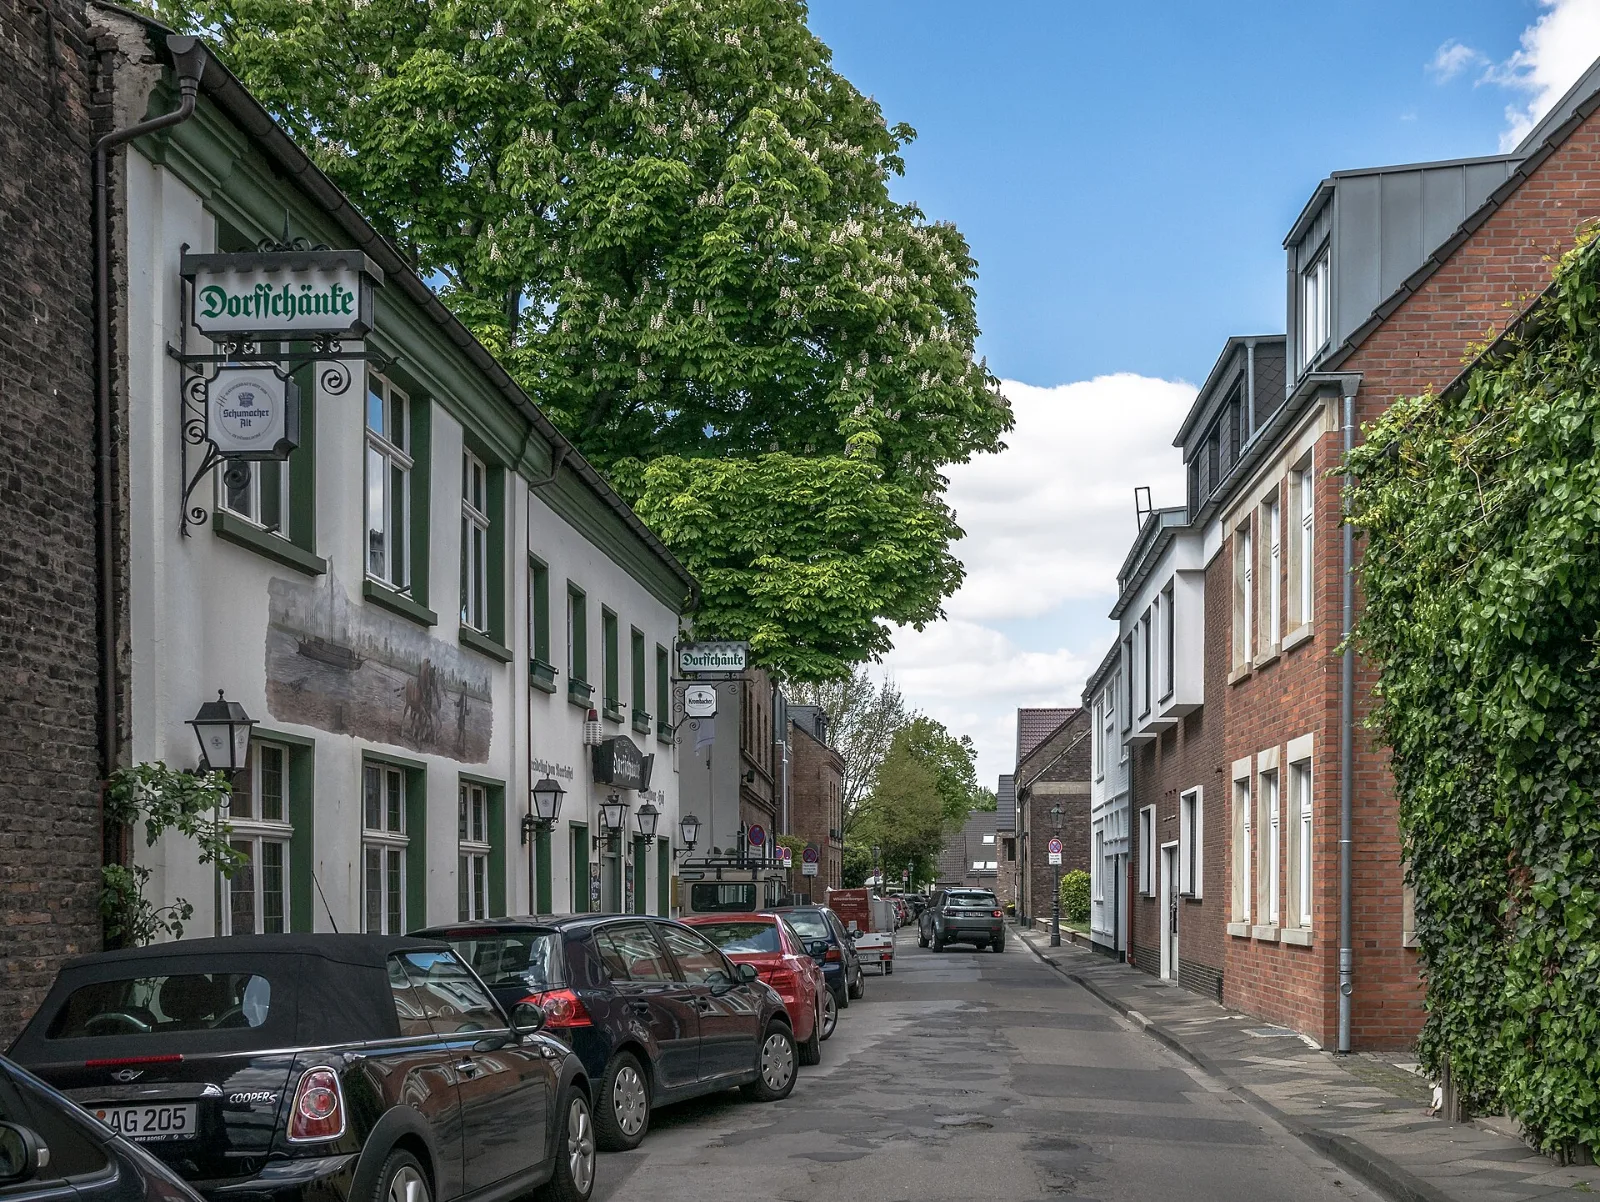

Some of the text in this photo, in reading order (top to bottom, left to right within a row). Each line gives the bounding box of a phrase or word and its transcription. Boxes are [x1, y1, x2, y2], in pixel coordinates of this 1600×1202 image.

[198, 282, 355, 322] Dorfschänke
[223, 408, 270, 419] Schumacher
[240, 418, 252, 429] Alt
[681, 653, 744, 668] Dorfschänke
[688, 697, 713, 705] Krombacher
[110, 1107, 187, 1133] AG 205
